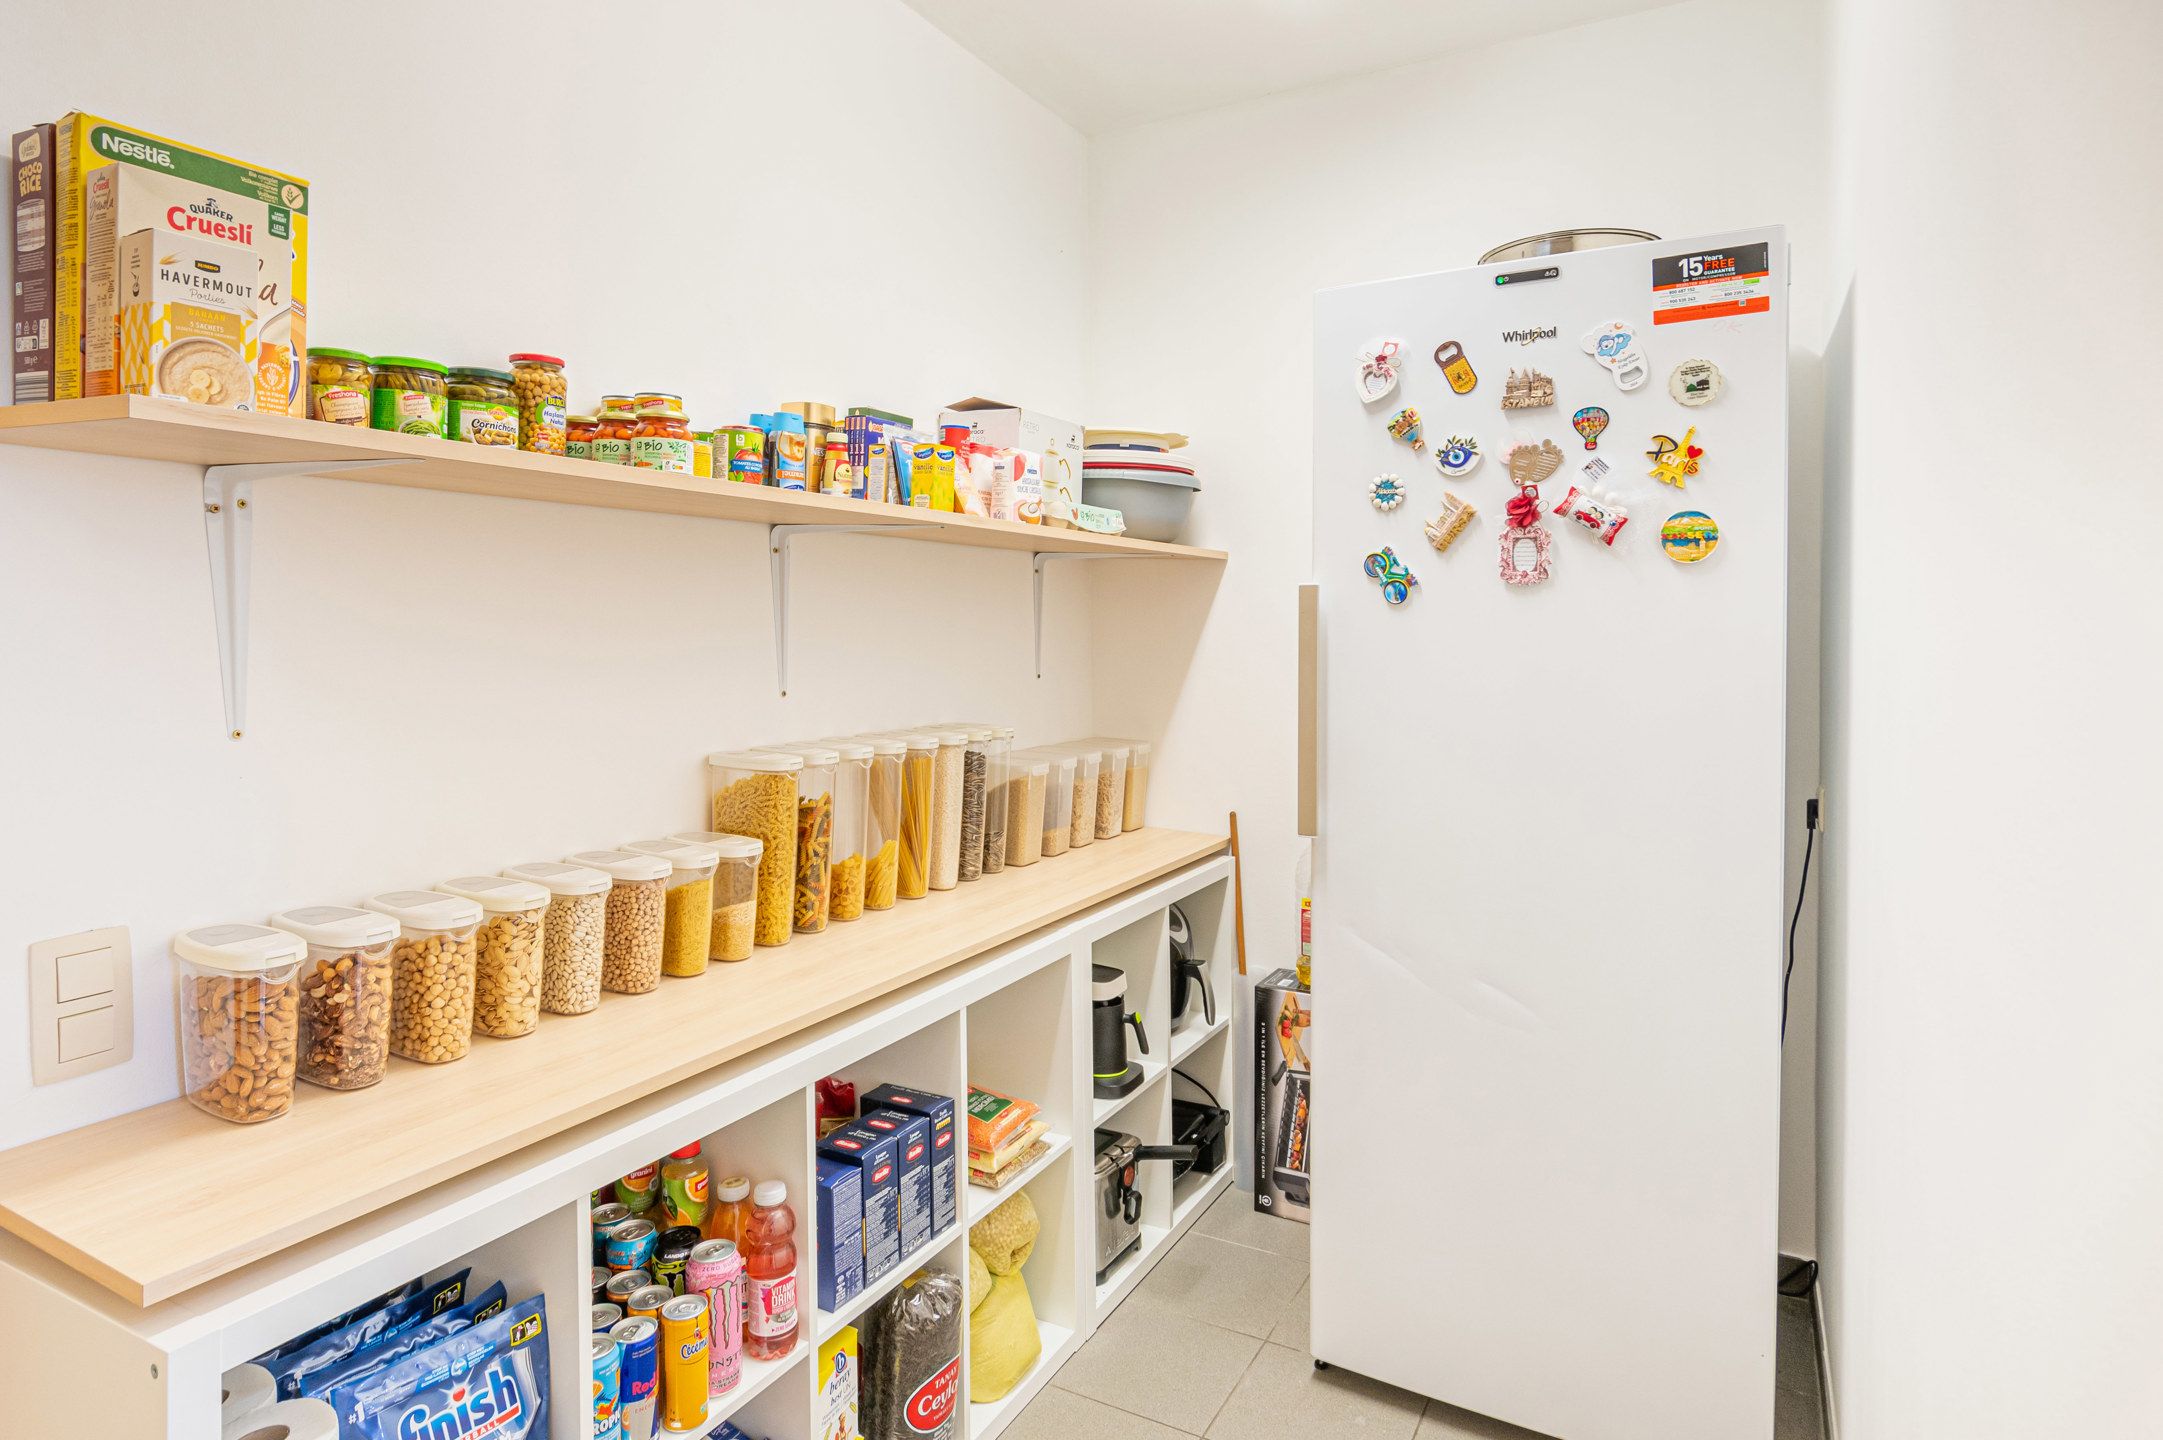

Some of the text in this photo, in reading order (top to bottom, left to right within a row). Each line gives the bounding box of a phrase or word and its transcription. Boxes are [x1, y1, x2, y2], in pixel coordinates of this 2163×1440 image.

[19, 162, 43, 181] CHOCO
[20, 174, 41, 197] RICE
[189, 203, 234, 222] QUAKER
[167, 206, 253, 245] Cruesli
[197, 263, 219, 271] JUMBO
[1678, 255, 1703, 278] 15
[1703, 267, 1735, 275] GUARANTEE
[1704, 257, 1735, 270] FREE
[160, 269, 252, 298] HAVERMOUT
[188, 307, 226, 321] BANAAN
[195, 322, 224, 333] SACHETS
[1502, 326, 1557, 342] Whirlpool
[328, 391, 357, 399] Freshona
[471, 418, 517, 434] Cornichons
[630, 1166, 652, 1179] granini
[632, 1372, 656, 1395] Red
[398, 1367, 521, 1440] finish
[348, 1401, 364, 1425] #1
